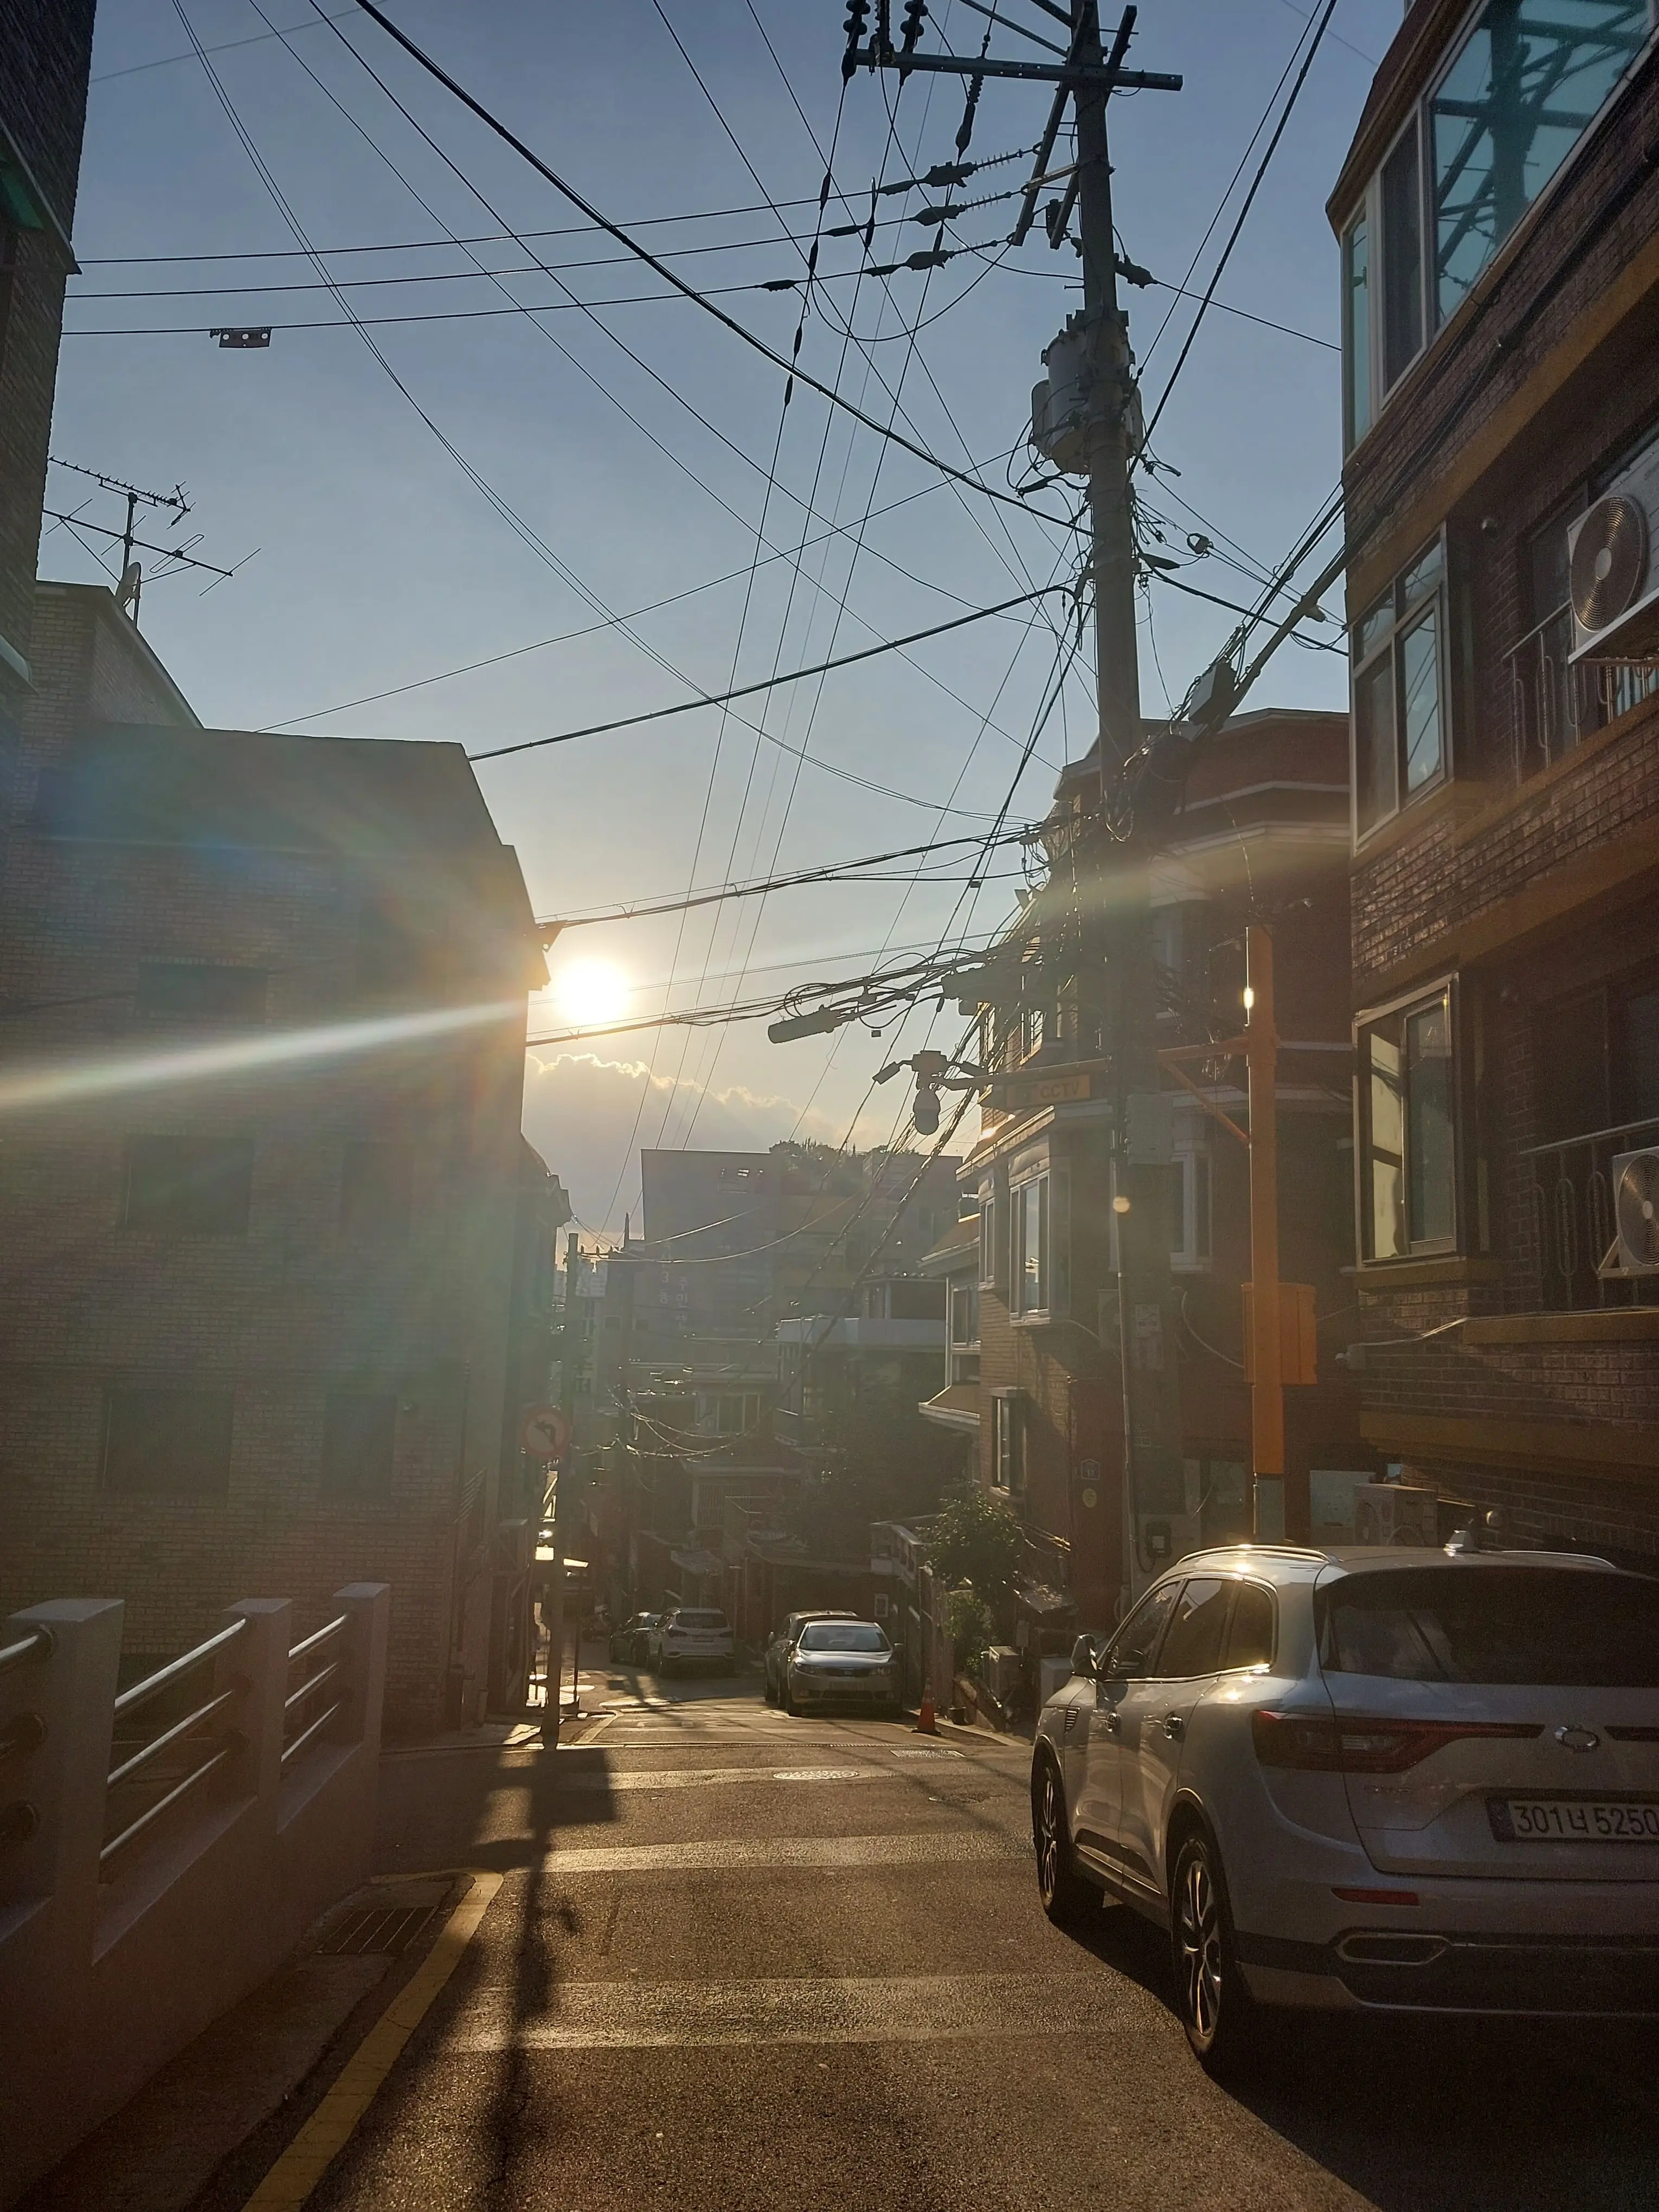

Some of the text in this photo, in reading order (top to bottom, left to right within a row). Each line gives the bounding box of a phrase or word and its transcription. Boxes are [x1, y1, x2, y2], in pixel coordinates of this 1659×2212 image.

[1040, 1081, 1079, 1098] CCTV
[1513, 1804, 1659, 1835] 301너 5250
